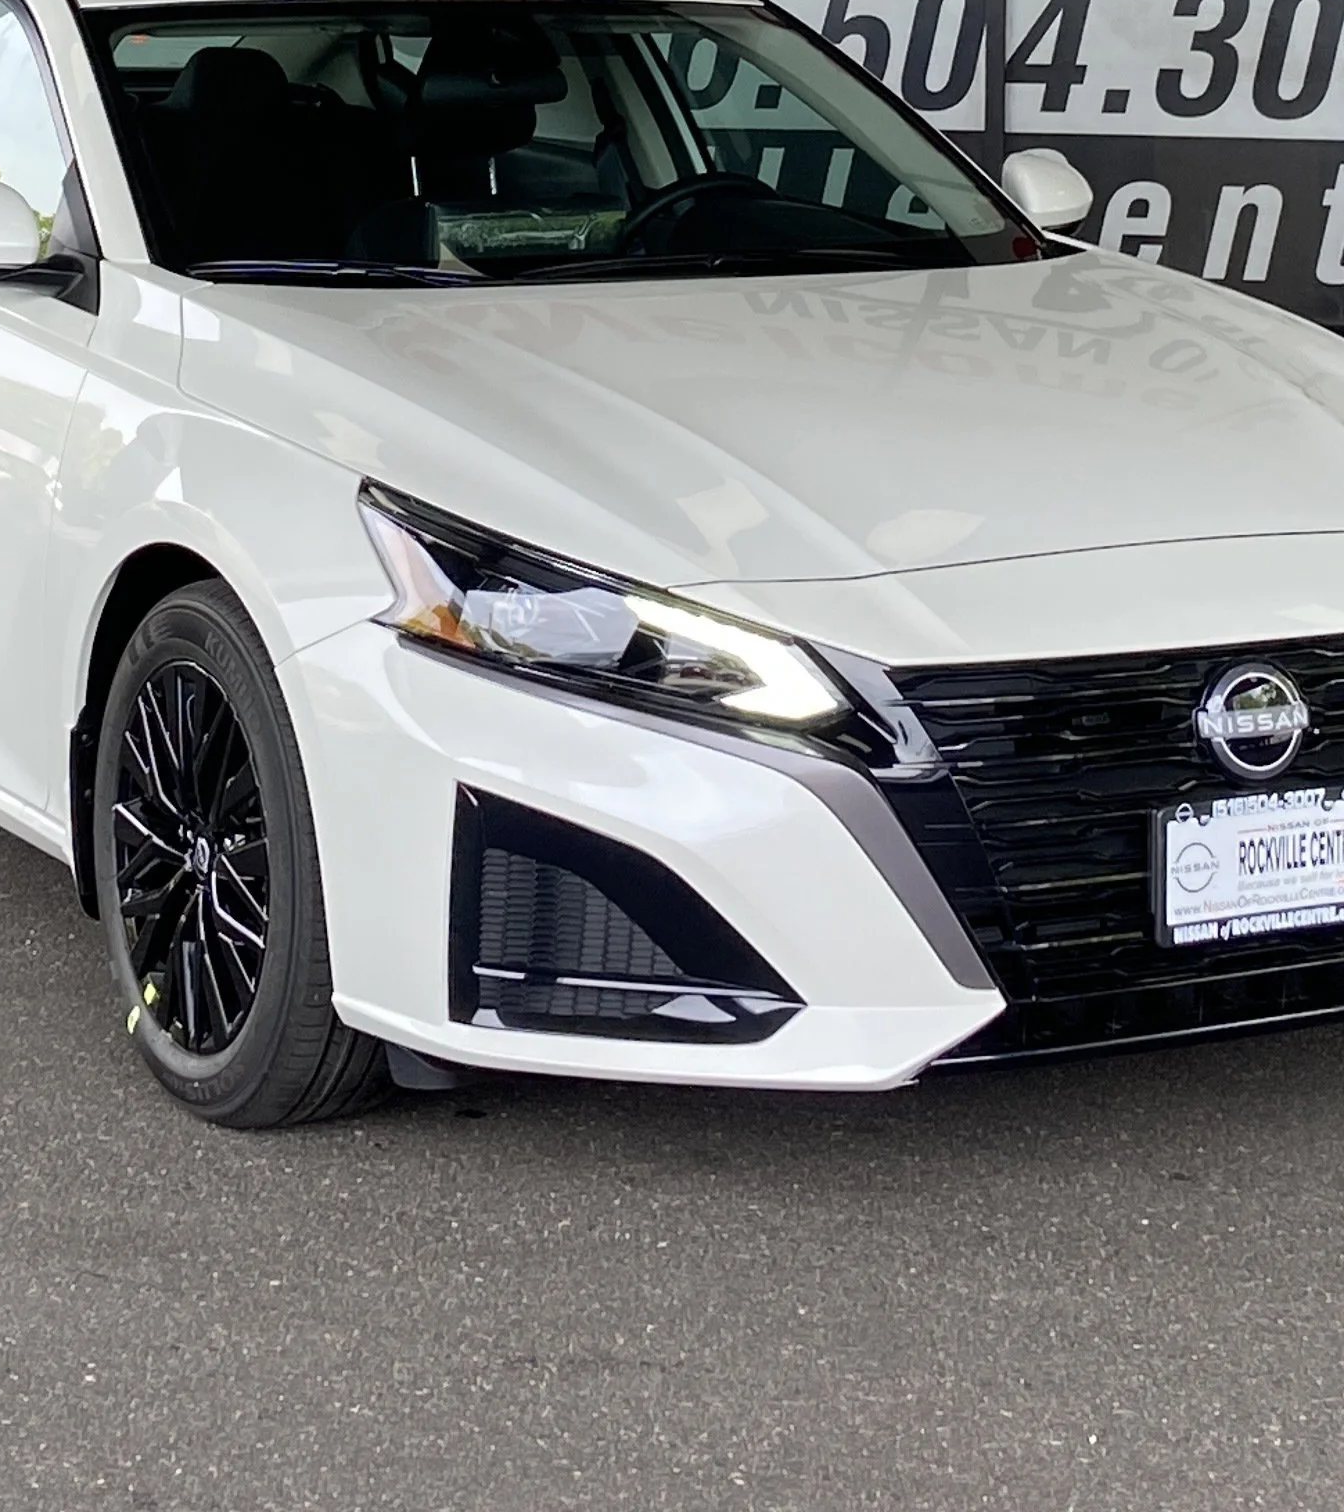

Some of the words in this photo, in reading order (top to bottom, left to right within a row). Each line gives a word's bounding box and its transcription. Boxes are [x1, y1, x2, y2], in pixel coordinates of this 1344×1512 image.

[1202, 710, 1308, 736] NISSAN
[1267, 819, 1310, 832] NISSAN
[1238, 833, 1307, 877] ROCKVILLE
[1170, 860, 1220, 875] NISSAN
[1173, 921, 1219, 945] NISSAN
